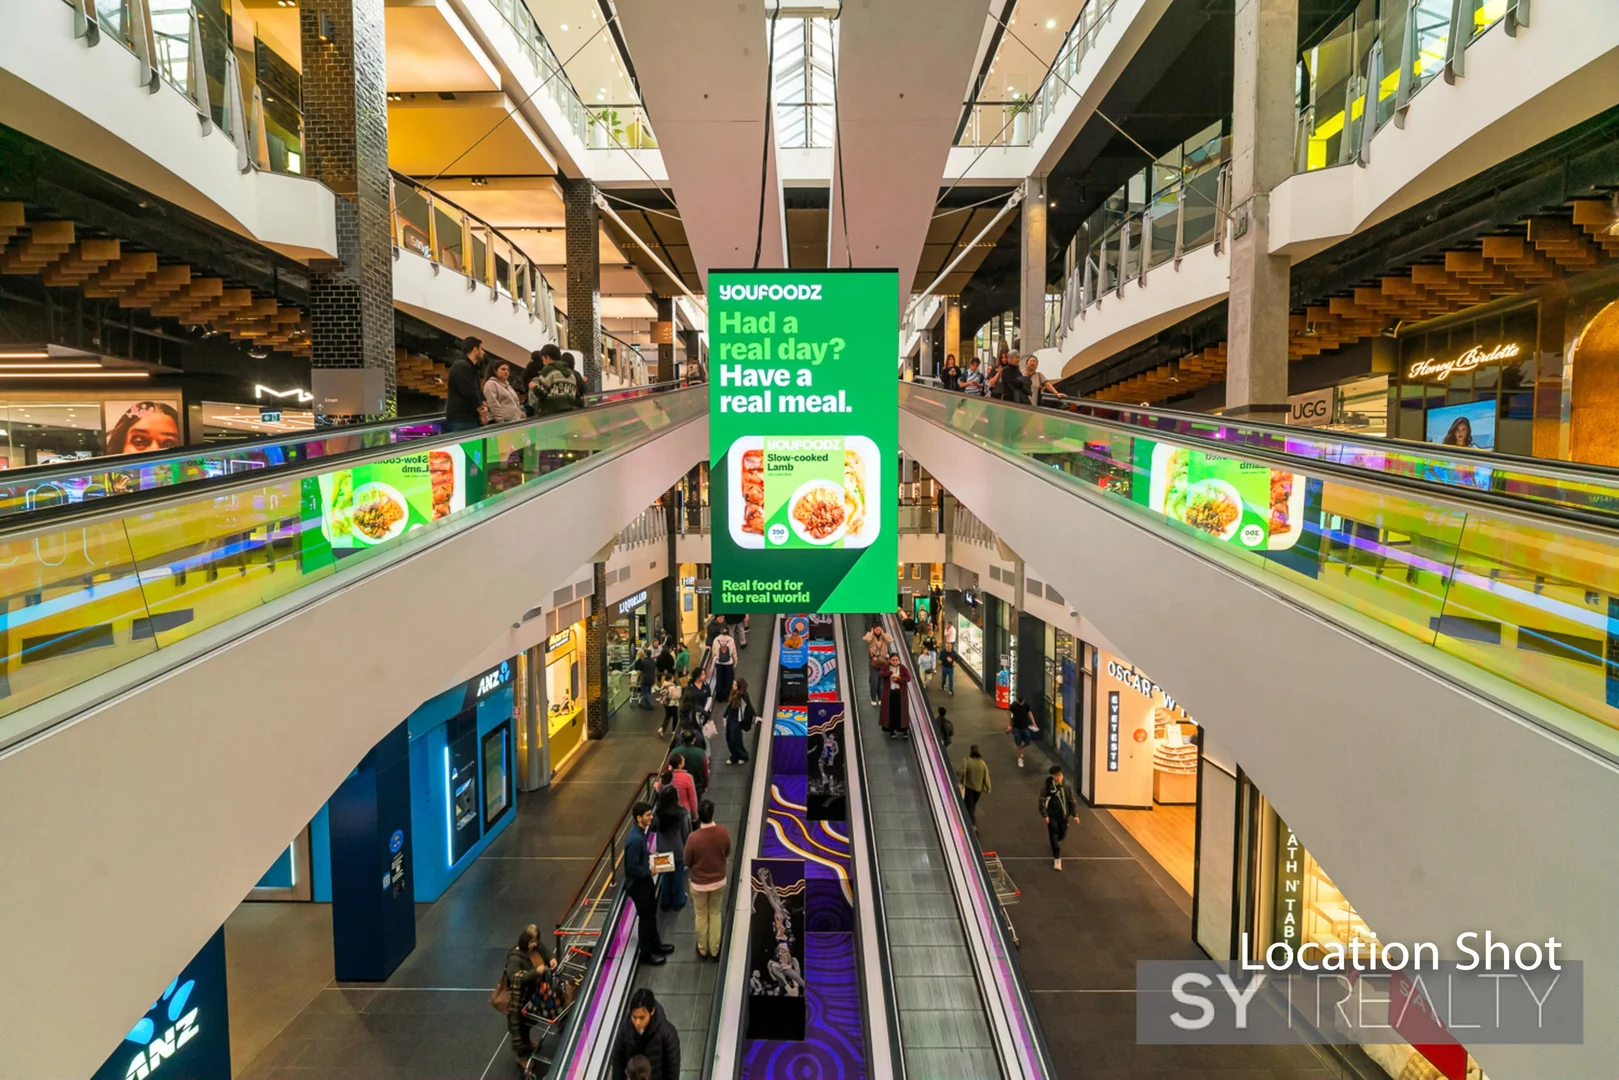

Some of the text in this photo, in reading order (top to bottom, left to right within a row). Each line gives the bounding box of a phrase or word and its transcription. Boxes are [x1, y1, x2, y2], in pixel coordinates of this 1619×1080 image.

[719, 284, 822, 301] YOUFOODZ
[720, 311, 798, 334] Had a
[720, 337, 845, 365] real day?
[1408, 343, 1520, 381] Honey Birdette
[720, 364, 812, 387] Have a
[720, 390, 852, 413] real meal.
[1293, 400, 1327, 419] UGG
[767, 439, 842, 451] YOUFOODZ
[767, 453, 829, 462] Slow-cooked
[767, 463, 794, 472] Lamb
[722, 579, 750, 591] Real
[752, 579, 781, 591] food
[784, 579, 803, 591] for
[722, 591, 810, 603] the real world
[476, 669, 500, 697] ANZ
[1107, 660, 1152, 699] OSCAR
[1286, 826, 1299, 873] ATH
[125, 1007, 200, 1080] ANZ
